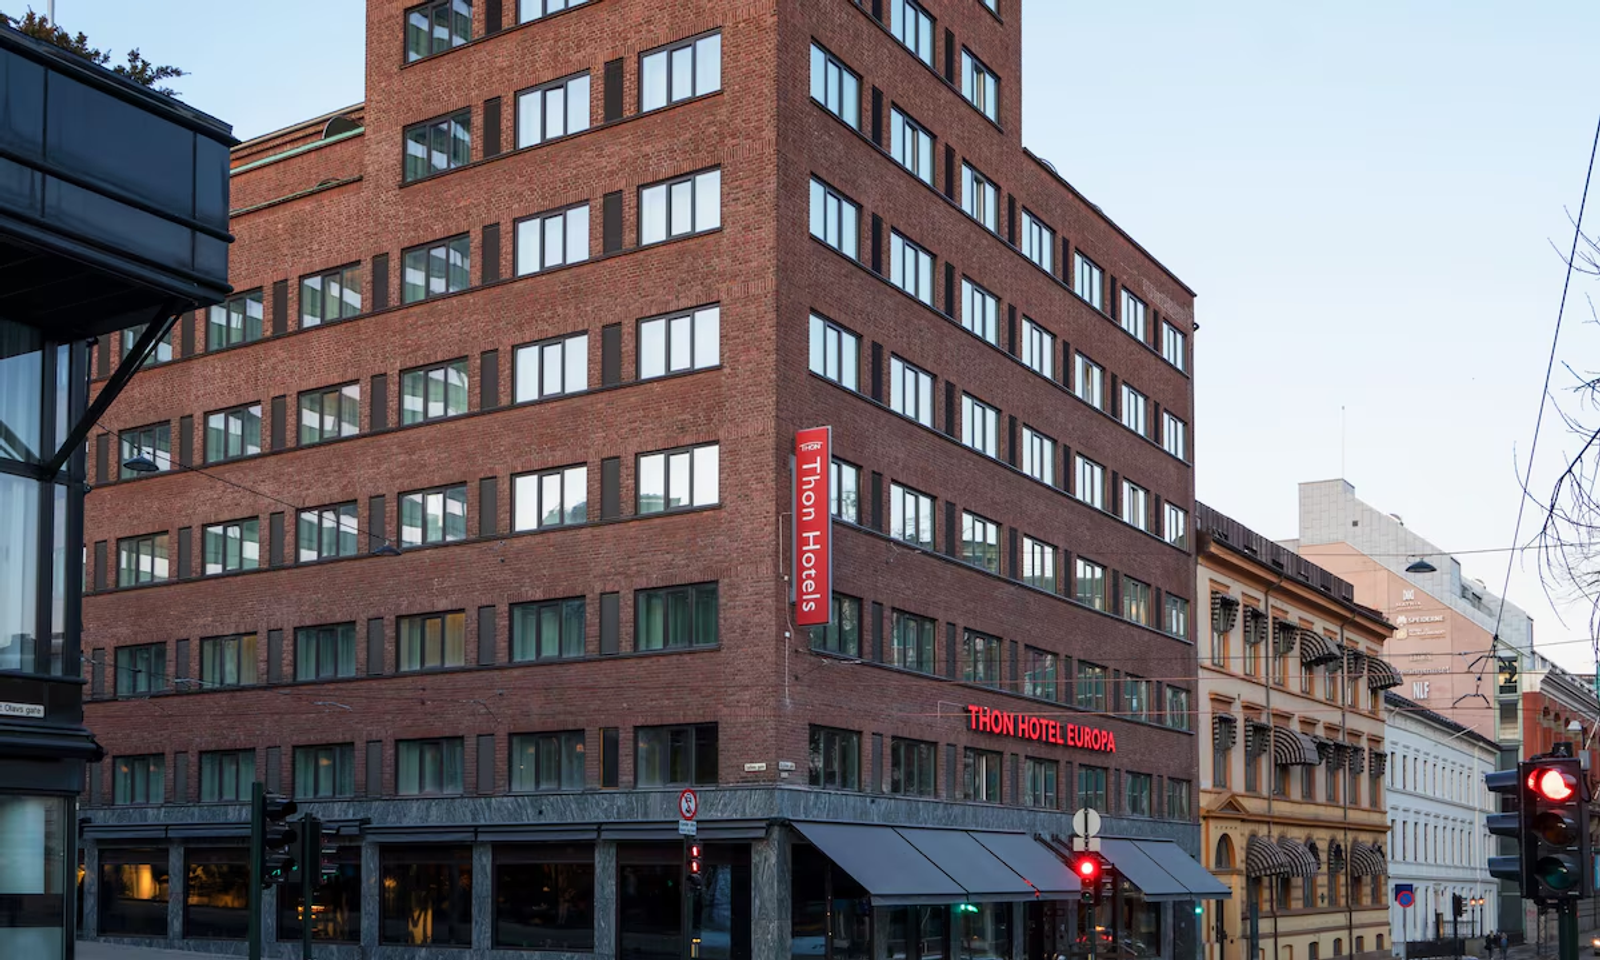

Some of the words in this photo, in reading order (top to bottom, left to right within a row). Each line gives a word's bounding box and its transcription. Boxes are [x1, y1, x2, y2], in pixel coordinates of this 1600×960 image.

[799, 442, 823, 452] THON
[802, 456, 820, 521] Thon
[802, 531, 821, 612] Hotels
[1413, 681, 1430, 699] NLF
[4, 704, 24, 713] Olavs
[26, 707, 41, 715] gate
[968, 704, 1014, 737] THON
[1018, 715, 1064, 745] HOTEL
[1066, 723, 1116, 753] EUROPA
